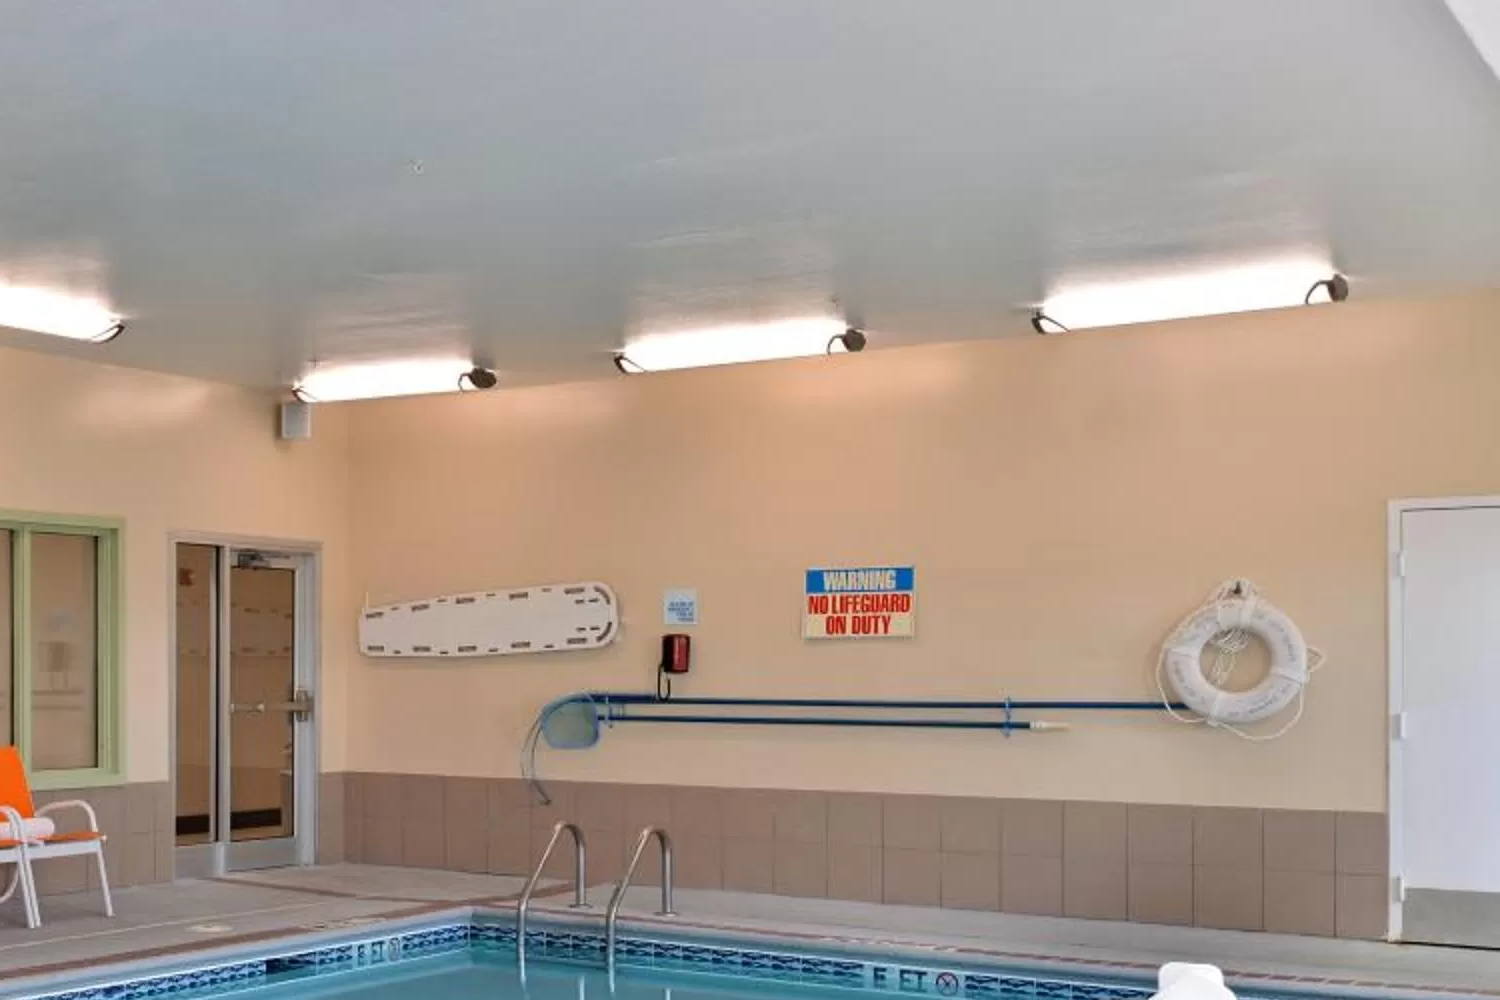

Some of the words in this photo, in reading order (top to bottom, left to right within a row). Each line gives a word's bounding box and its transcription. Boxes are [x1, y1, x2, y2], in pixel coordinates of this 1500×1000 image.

[823, 569, 897, 591] WARNING
[807, 594, 829, 615] NO
[831, 593, 911, 614] LIFEGUARD
[825, 615, 847, 635] ON
[852, 614, 892, 635] DUTY
